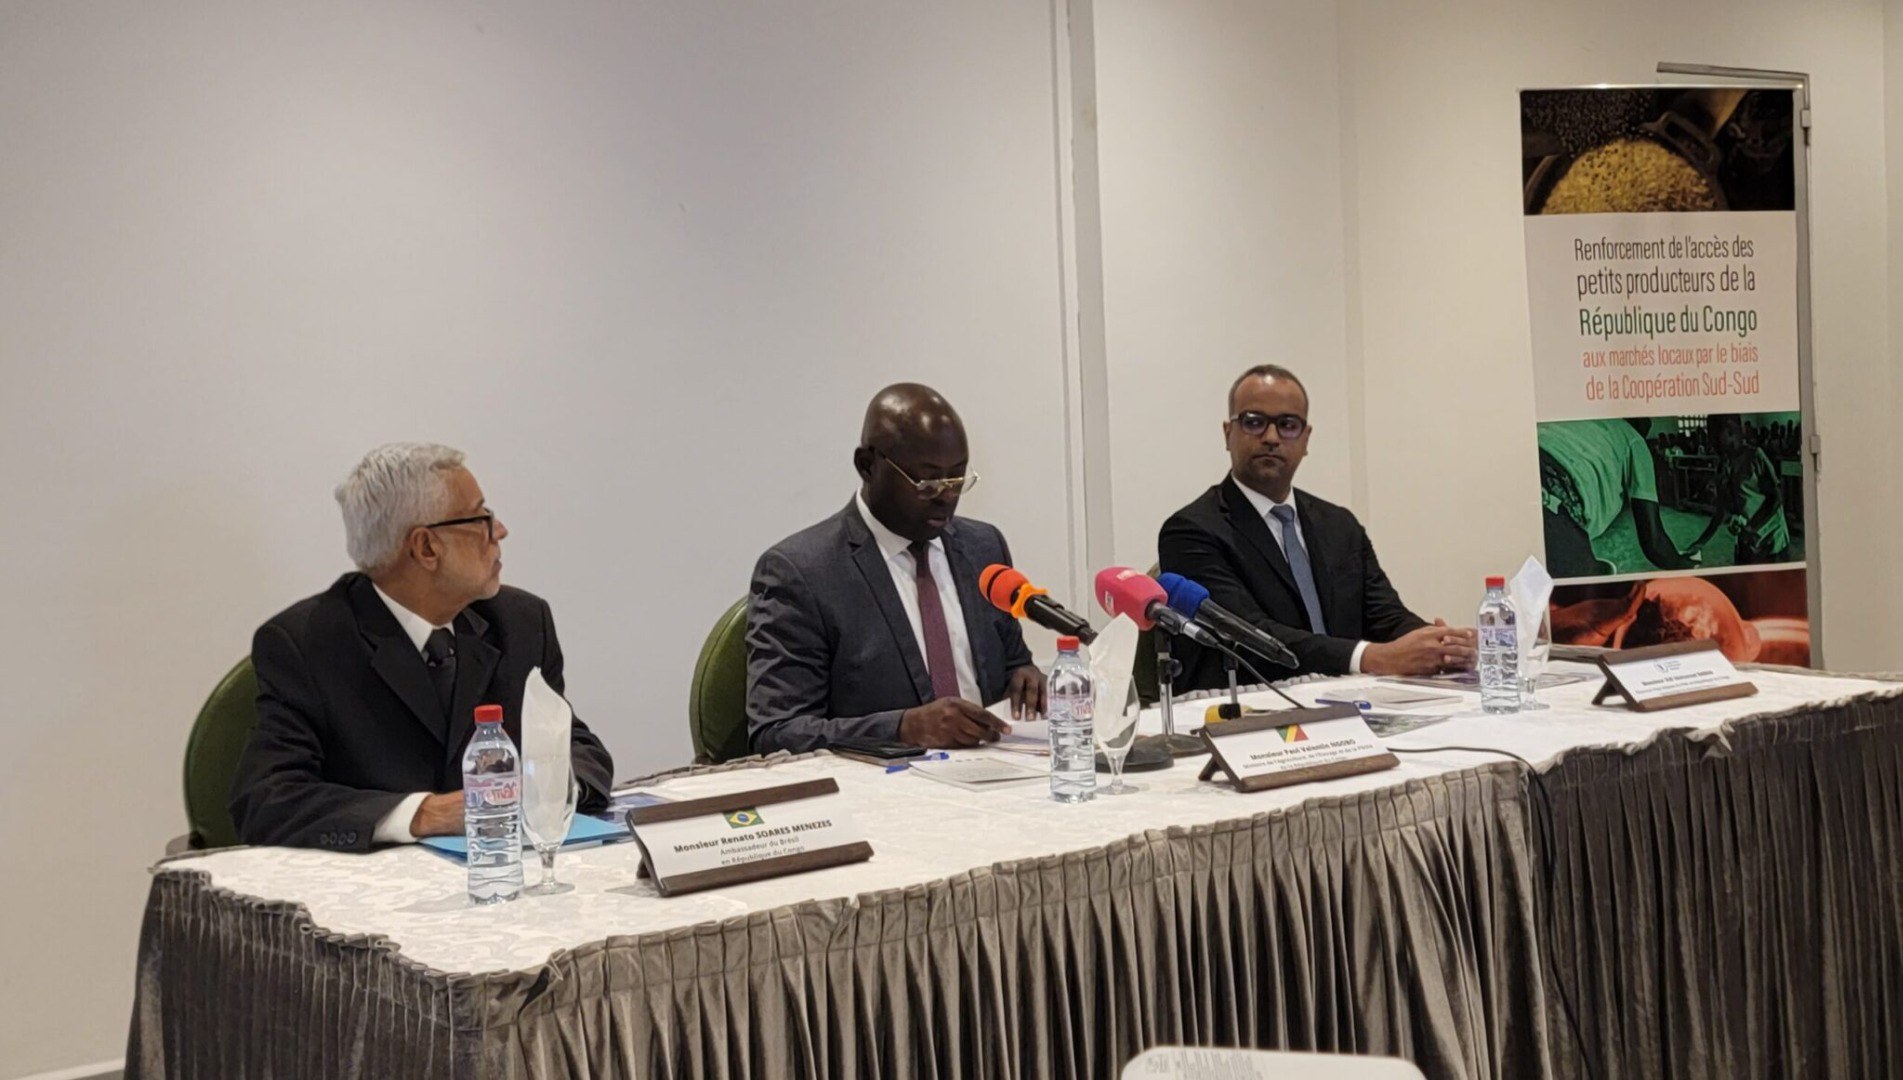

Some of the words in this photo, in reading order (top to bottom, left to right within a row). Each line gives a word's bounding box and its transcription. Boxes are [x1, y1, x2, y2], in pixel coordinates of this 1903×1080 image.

[1574, 236, 1665, 261] Renforcement
[1668, 235, 1682, 259] de
[1685, 234, 1729, 259] l'accès
[1732, 234, 1754, 258] des
[1577, 266, 1622, 301] petits
[1626, 265, 1715, 300] producteurs
[1720, 264, 1739, 292] de
[1743, 264, 1755, 291] la
[1579, 304, 1676, 341] République
[1680, 304, 1699, 333] du
[1703, 304, 1757, 338] Congo
[1582, 351, 1606, 368] aux
[1609, 344, 1655, 367] marchés
[1657, 344, 1694, 366] locaux
[1696, 348, 1713, 368] par
[1716, 342, 1727, 364] le
[1731, 342, 1759, 363] biais
[1586, 374, 1604, 401] de
[1608, 374, 1619, 400] la
[1622, 371, 1700, 404] Coopération
[1702, 369, 1759, 397] Sud-Sud
[673, 838, 719, 854] Monsieur
[721, 834, 755, 846] Renato
[756, 827, 791, 839] SOARES
[792, 819, 832, 833] MENEZES
[720, 843, 768, 856] Ambassadeur
[769, 839, 778, 847] du
[780, 835, 799, 846] Brésil
